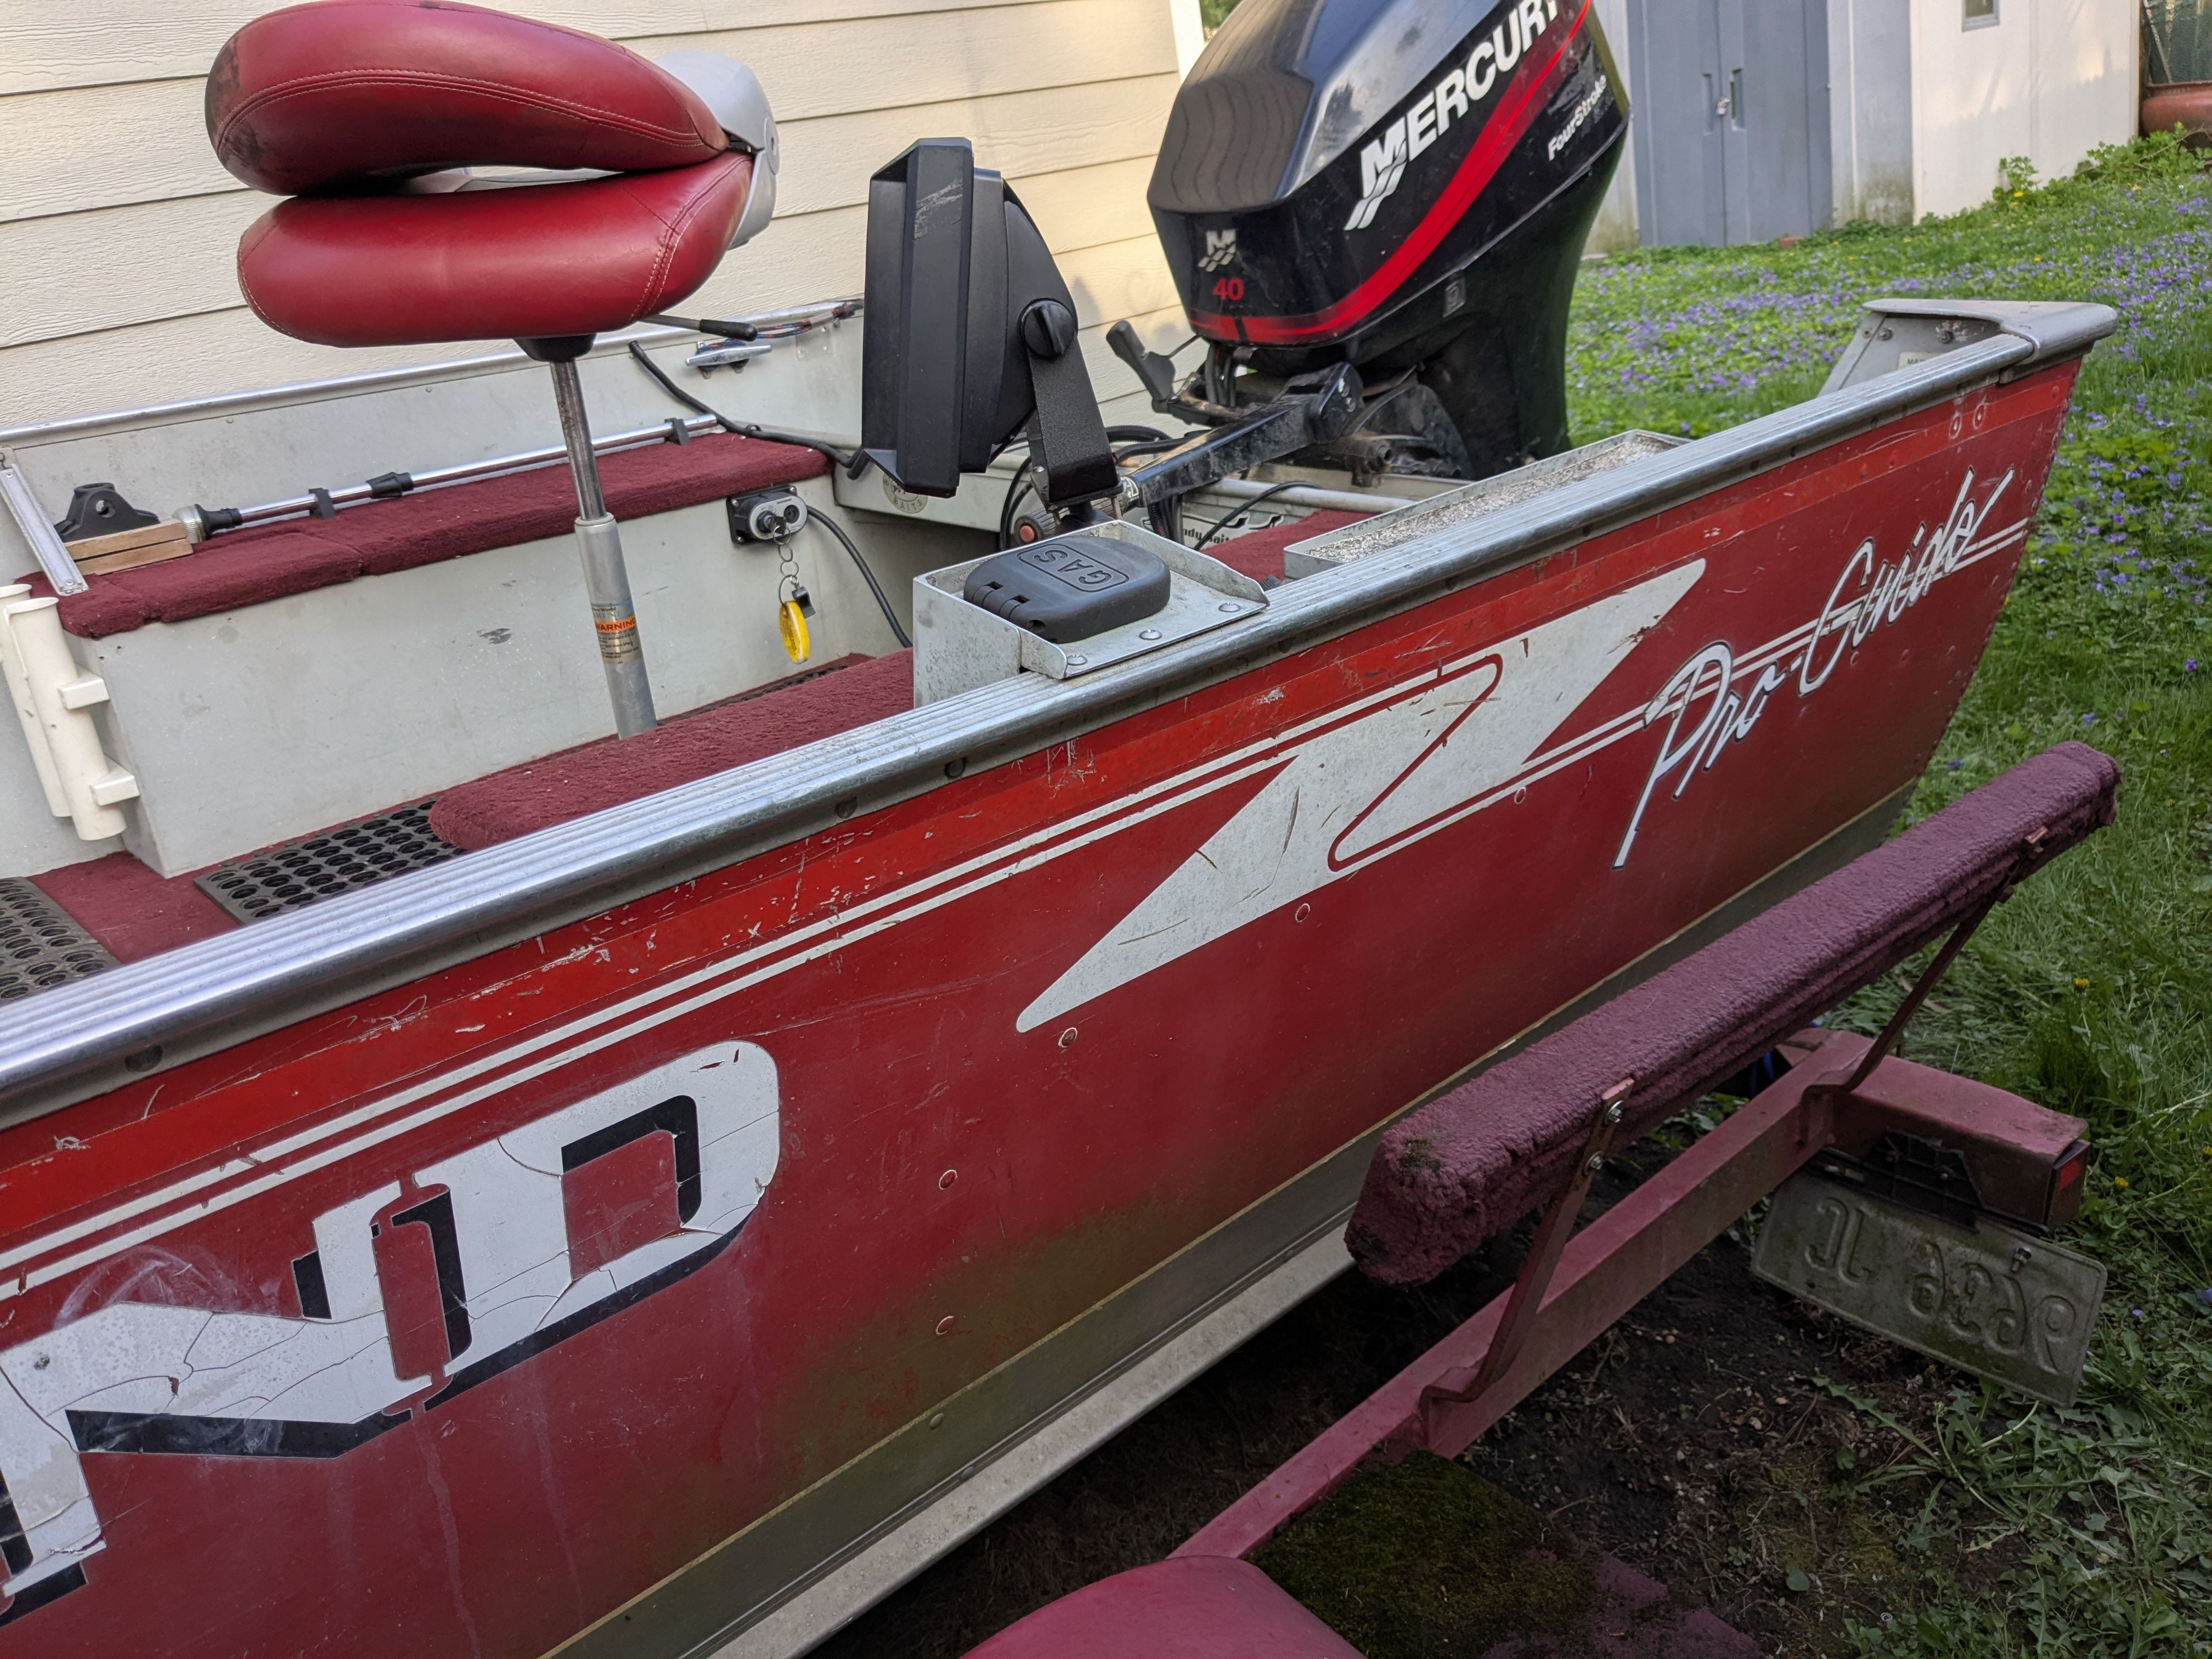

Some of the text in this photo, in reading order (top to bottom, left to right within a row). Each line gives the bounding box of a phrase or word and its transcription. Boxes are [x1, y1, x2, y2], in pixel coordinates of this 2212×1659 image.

[1548, 75, 1607, 162] FourStroke
[1212, 278, 1244, 301] 40
[894, 497, 923, 511] BAITS
[1033, 550, 1113, 585] GAS
[1612, 465, 2015, 870] Pro-Guide
